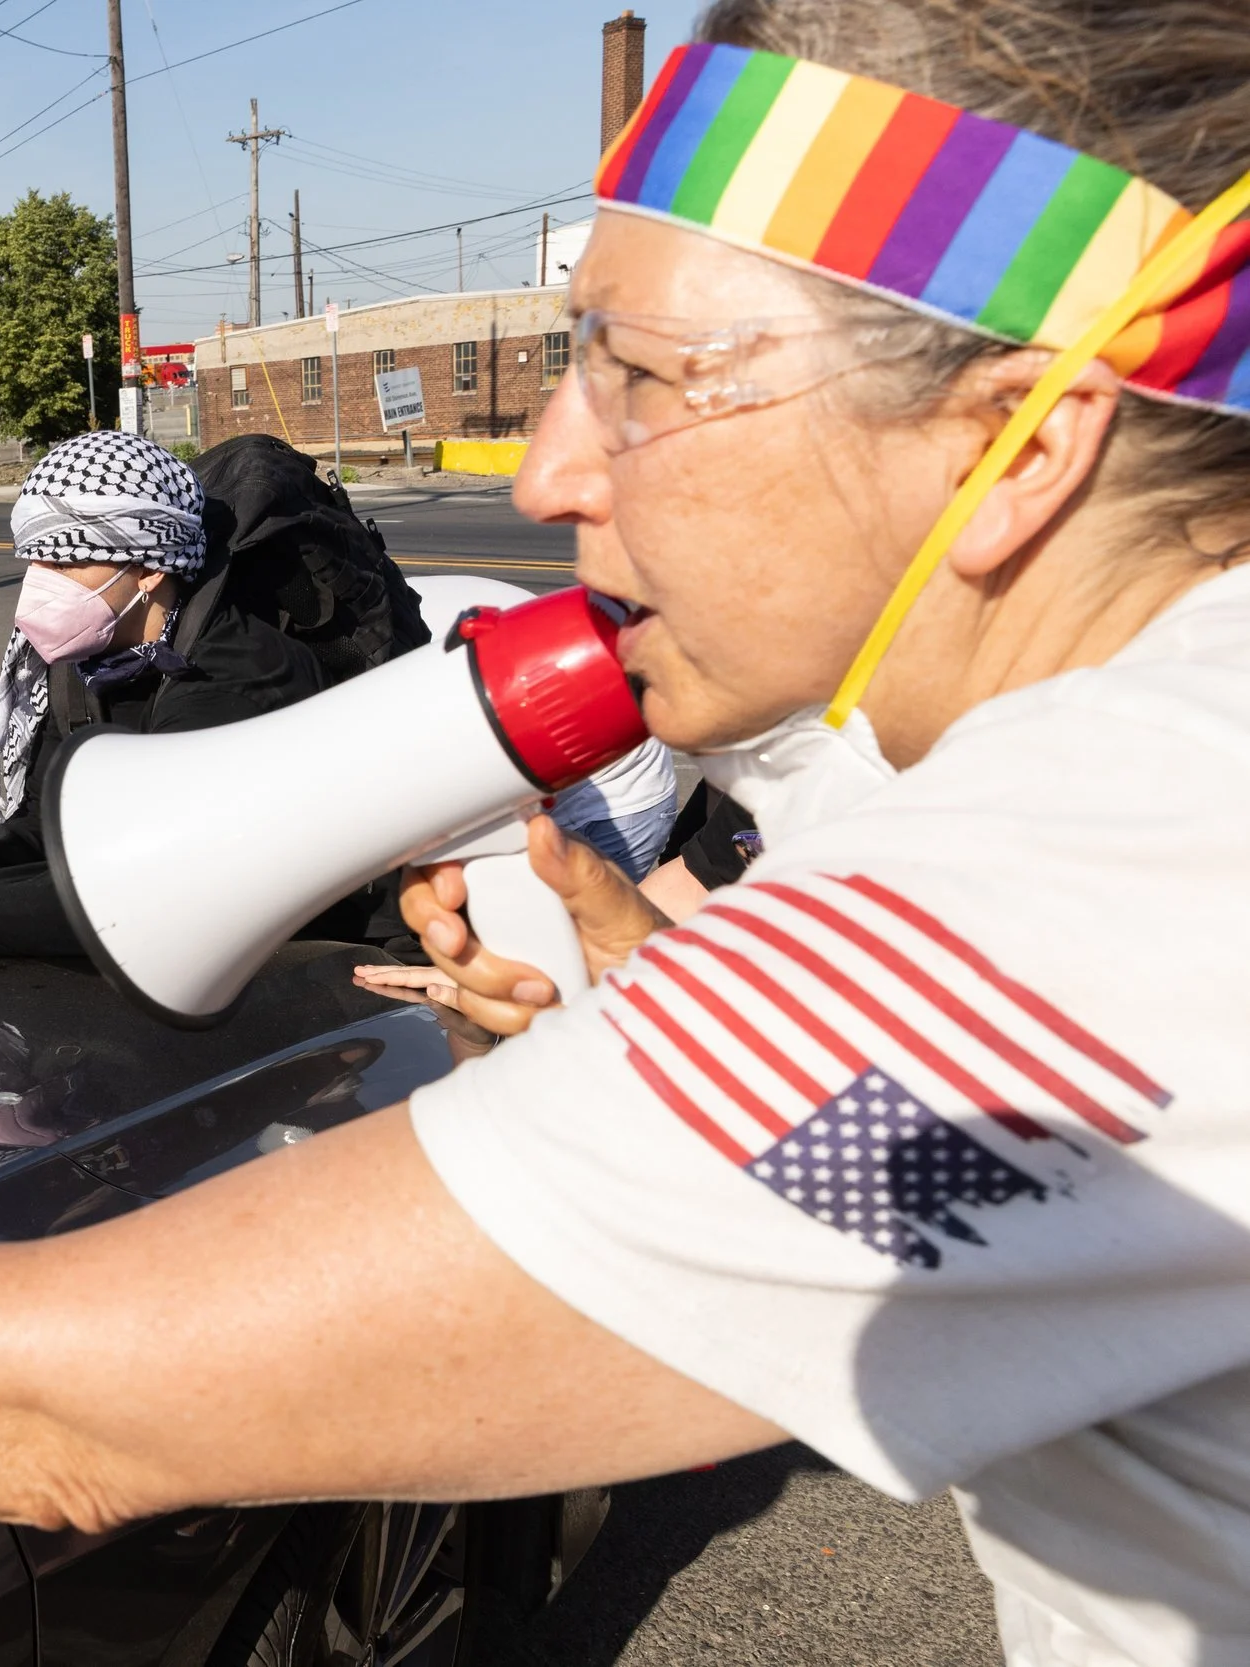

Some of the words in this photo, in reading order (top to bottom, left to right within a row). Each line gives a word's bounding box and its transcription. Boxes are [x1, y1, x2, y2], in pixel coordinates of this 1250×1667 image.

[124, 320, 132, 353] TRUCK
[384, 408, 397, 420] MAIN
[397, 402, 423, 417] ENTRANCE
